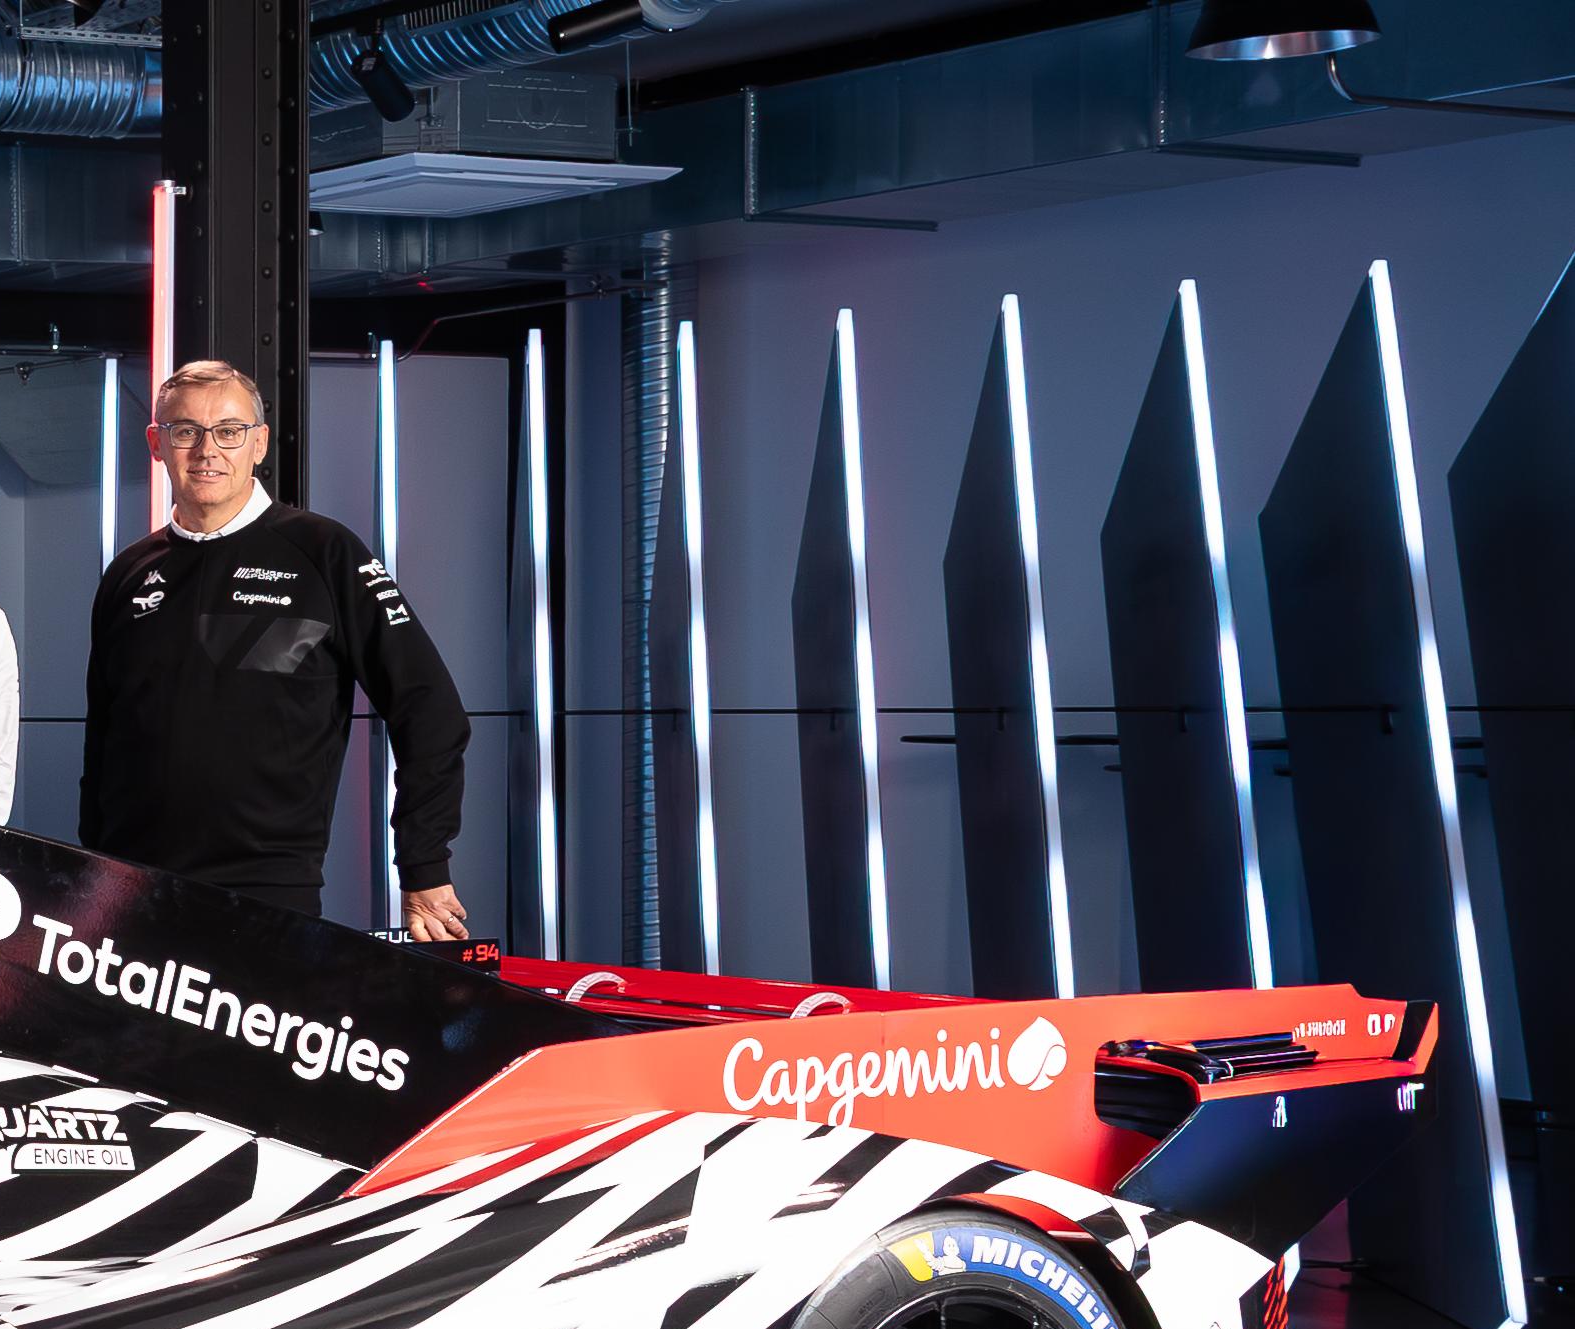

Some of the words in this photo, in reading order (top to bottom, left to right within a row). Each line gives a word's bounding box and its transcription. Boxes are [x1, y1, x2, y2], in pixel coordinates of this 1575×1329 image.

[244, 573, 279, 581] SPORT
[248, 567, 298, 580] PEUGEOT
[233, 591, 280, 605] Capgemini
[32, 914, 409, 1091] TotalEnergies
[723, 1028, 1005, 1127] Capgemini
[34, 1149, 96, 1165] ENGINE
[101, 1150, 128, 1165] OIL
